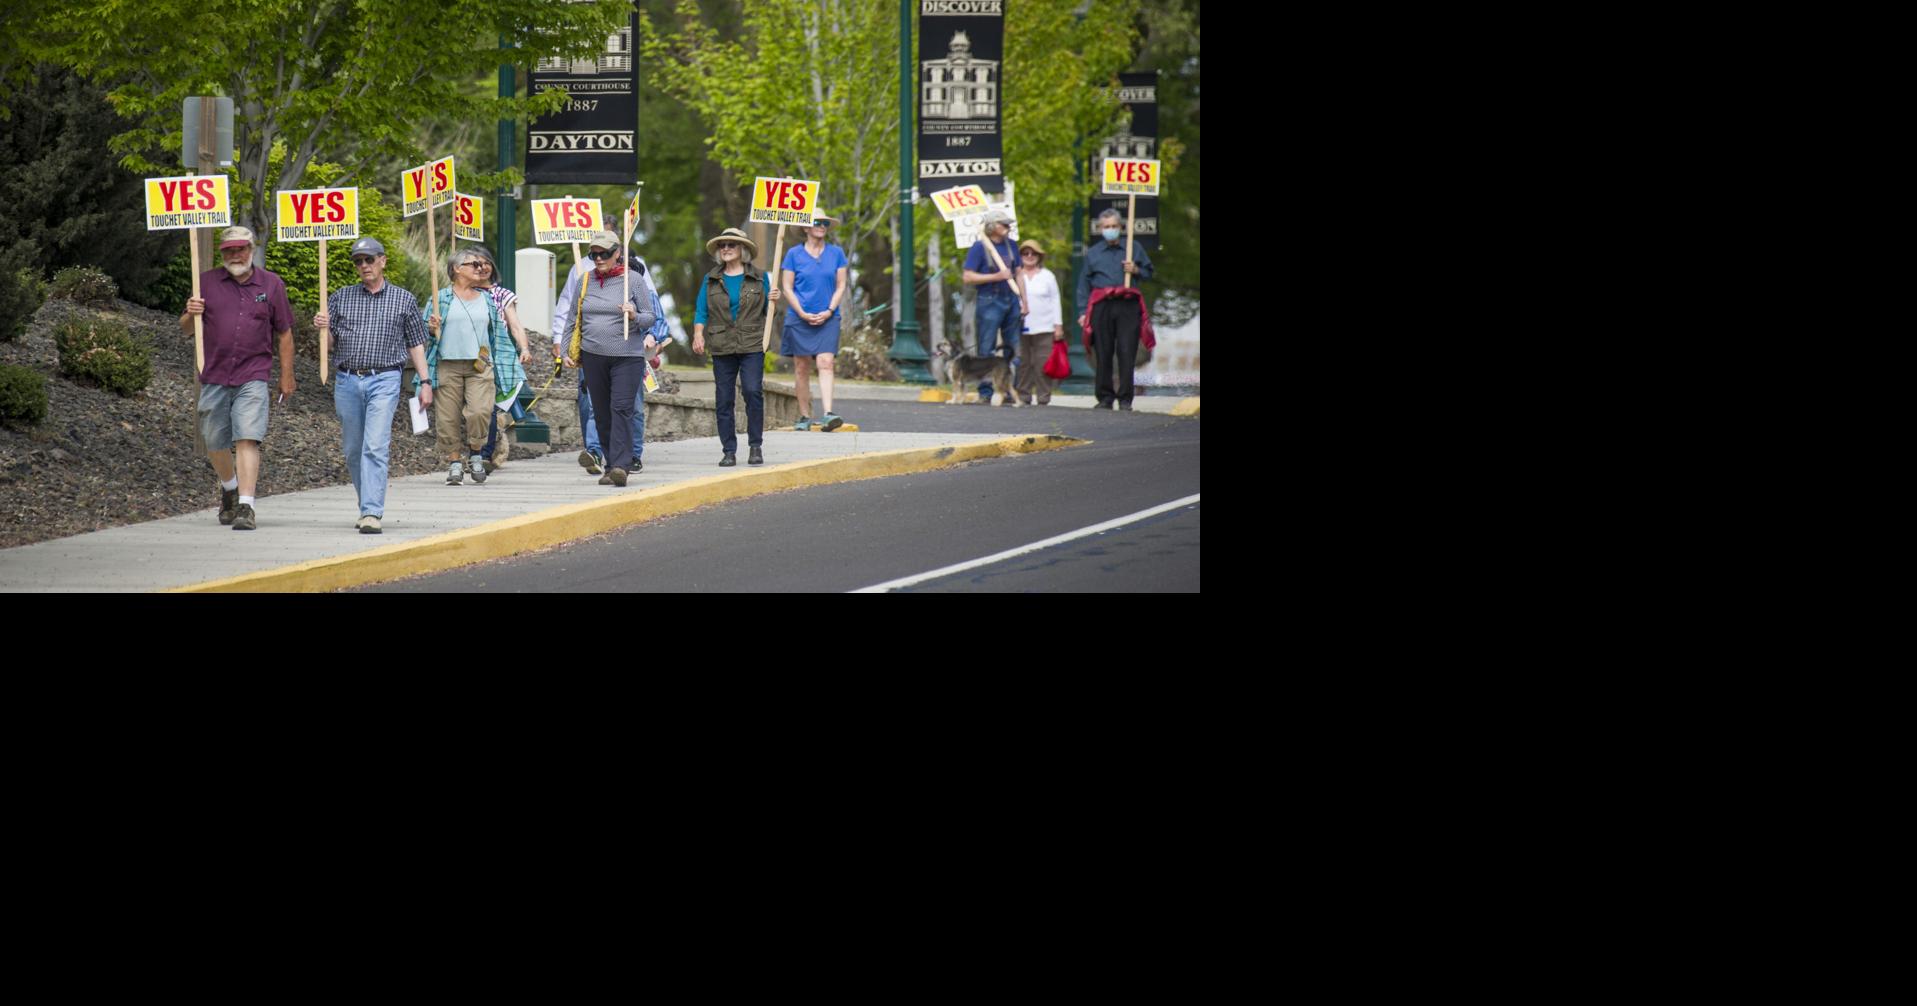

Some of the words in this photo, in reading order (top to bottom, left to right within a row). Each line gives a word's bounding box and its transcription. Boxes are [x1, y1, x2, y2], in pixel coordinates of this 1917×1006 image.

[922, 1, 1002, 13] DISCOVER
[573, 82, 631, 90] COURTHOUSE
[566, 99, 598, 112] 1887
[530, 134, 633, 150] DAYTON
[946, 136, 972, 147] 1887
[920, 161, 1000, 175] DAYTON
[1114, 161, 1151, 184] YES
[159, 179, 216, 212] YES
[765, 180, 808, 211] YES
[942, 188, 980, 209] YES
[290, 191, 345, 224] YES
[543, 201, 593, 229] YES
[151, 213, 181, 227] TOUCHET
[183, 212, 206, 225] VALLEY
[208, 211, 227, 224] TRAIL
[753, 208, 777, 221] TOUCHET
[777, 210, 795, 222] VALLEY
[796, 212, 812, 224] TRAIL
[281, 226, 311, 239] TOUCHET
[313, 224, 335, 237] VALLEY
[337, 223, 355, 236] TRAIL
[466, 226, 481, 239] TRAIL
[538, 230, 566, 242] TOUCHET
[567, 230, 586, 241] VALLEY
